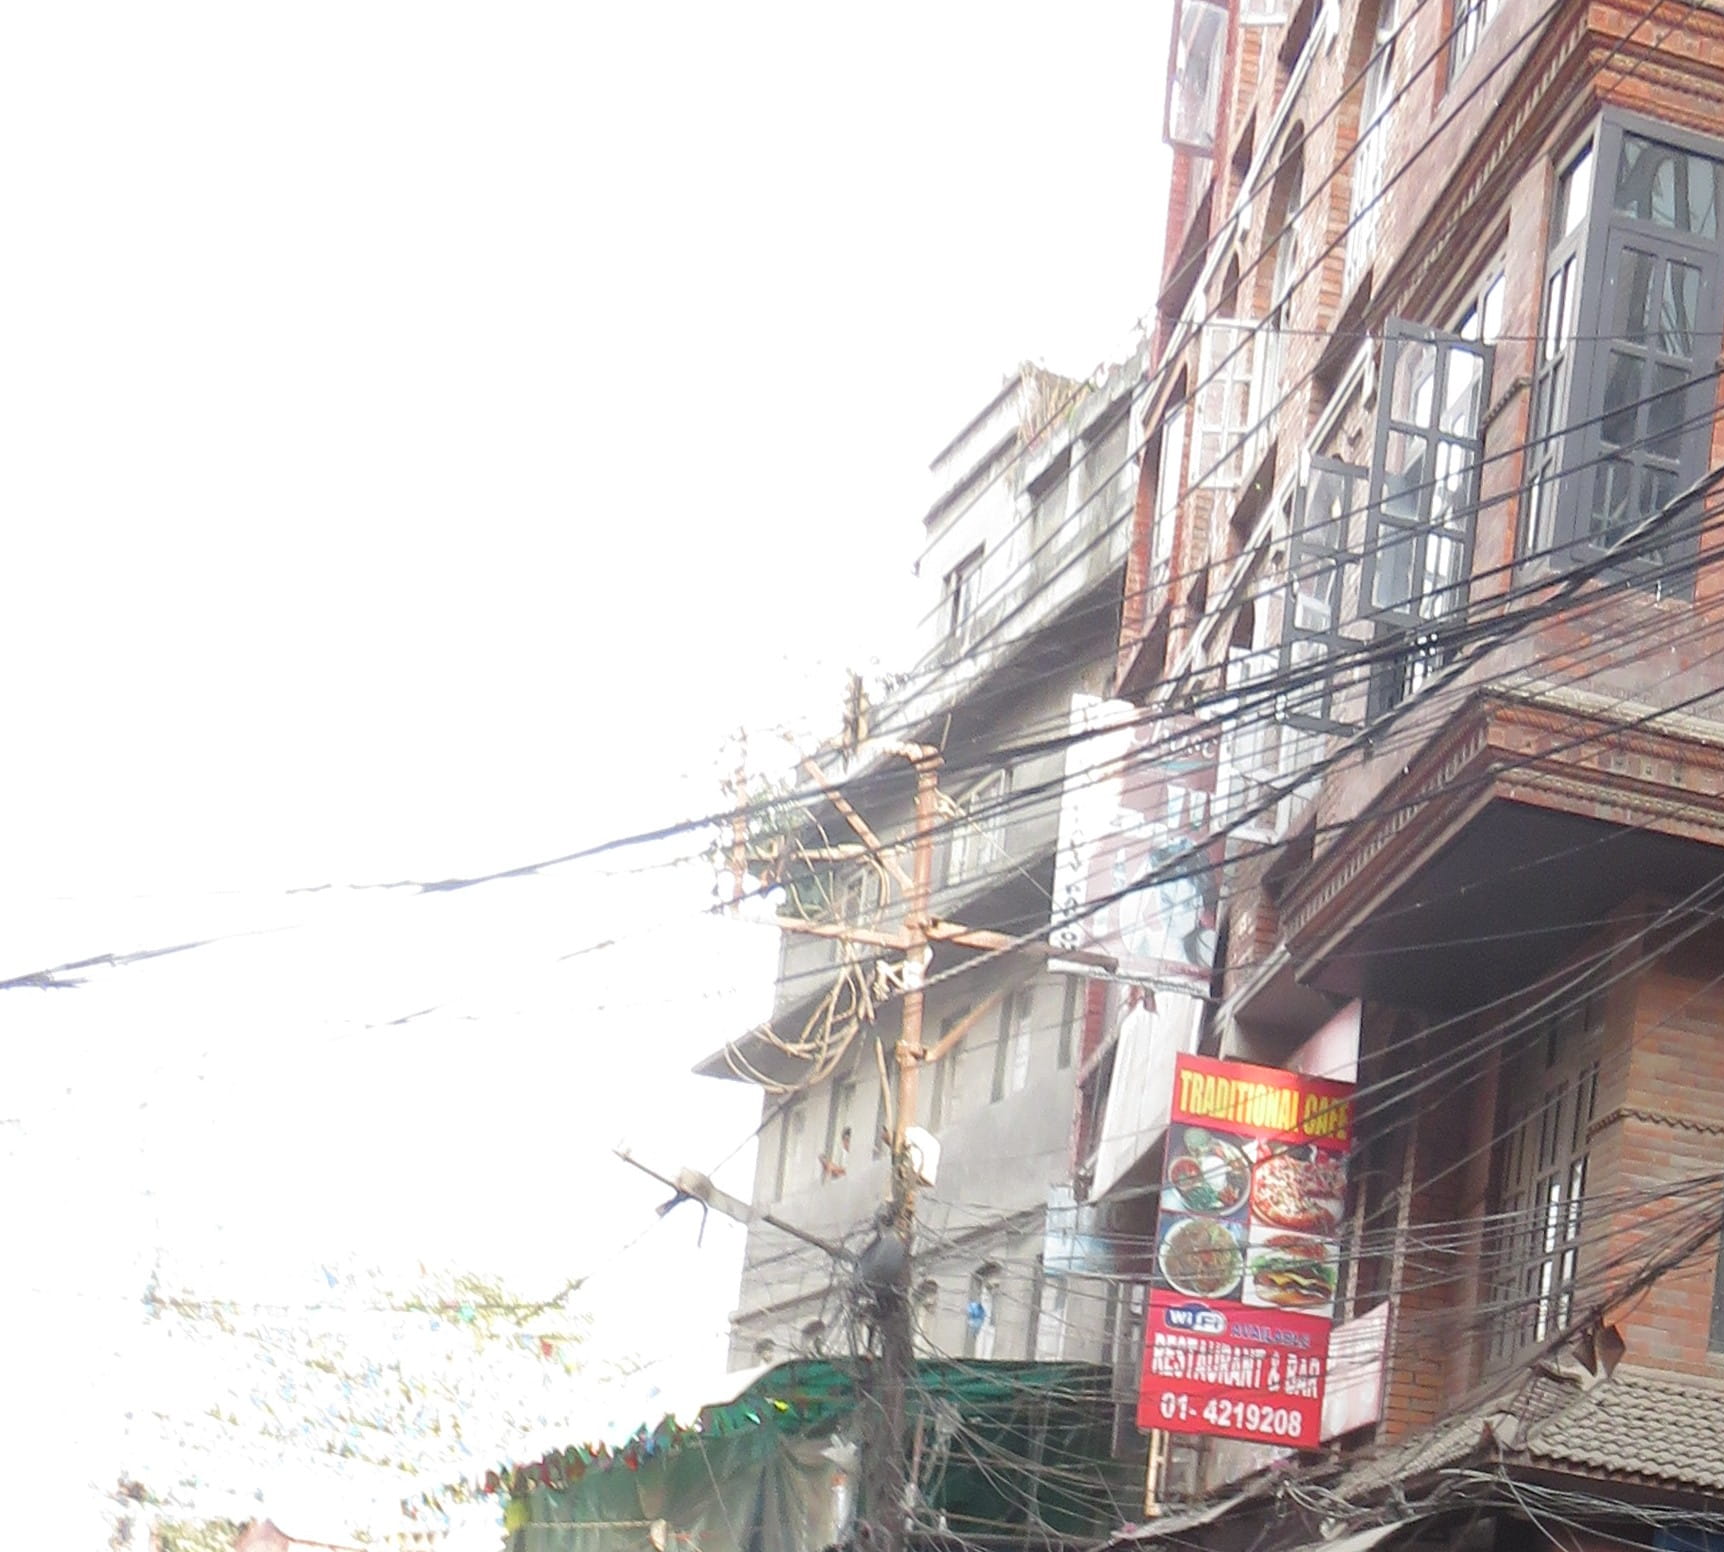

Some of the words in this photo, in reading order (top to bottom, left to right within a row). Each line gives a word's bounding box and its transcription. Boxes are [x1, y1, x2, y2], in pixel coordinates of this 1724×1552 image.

[1180, 1069, 1299, 1133] TRADITIONAL
[1151, 1332, 1266, 1388] RESTAURANT
[1284, 1353, 1321, 1399] BAR
[1202, 1398, 1302, 1438] 4219208
